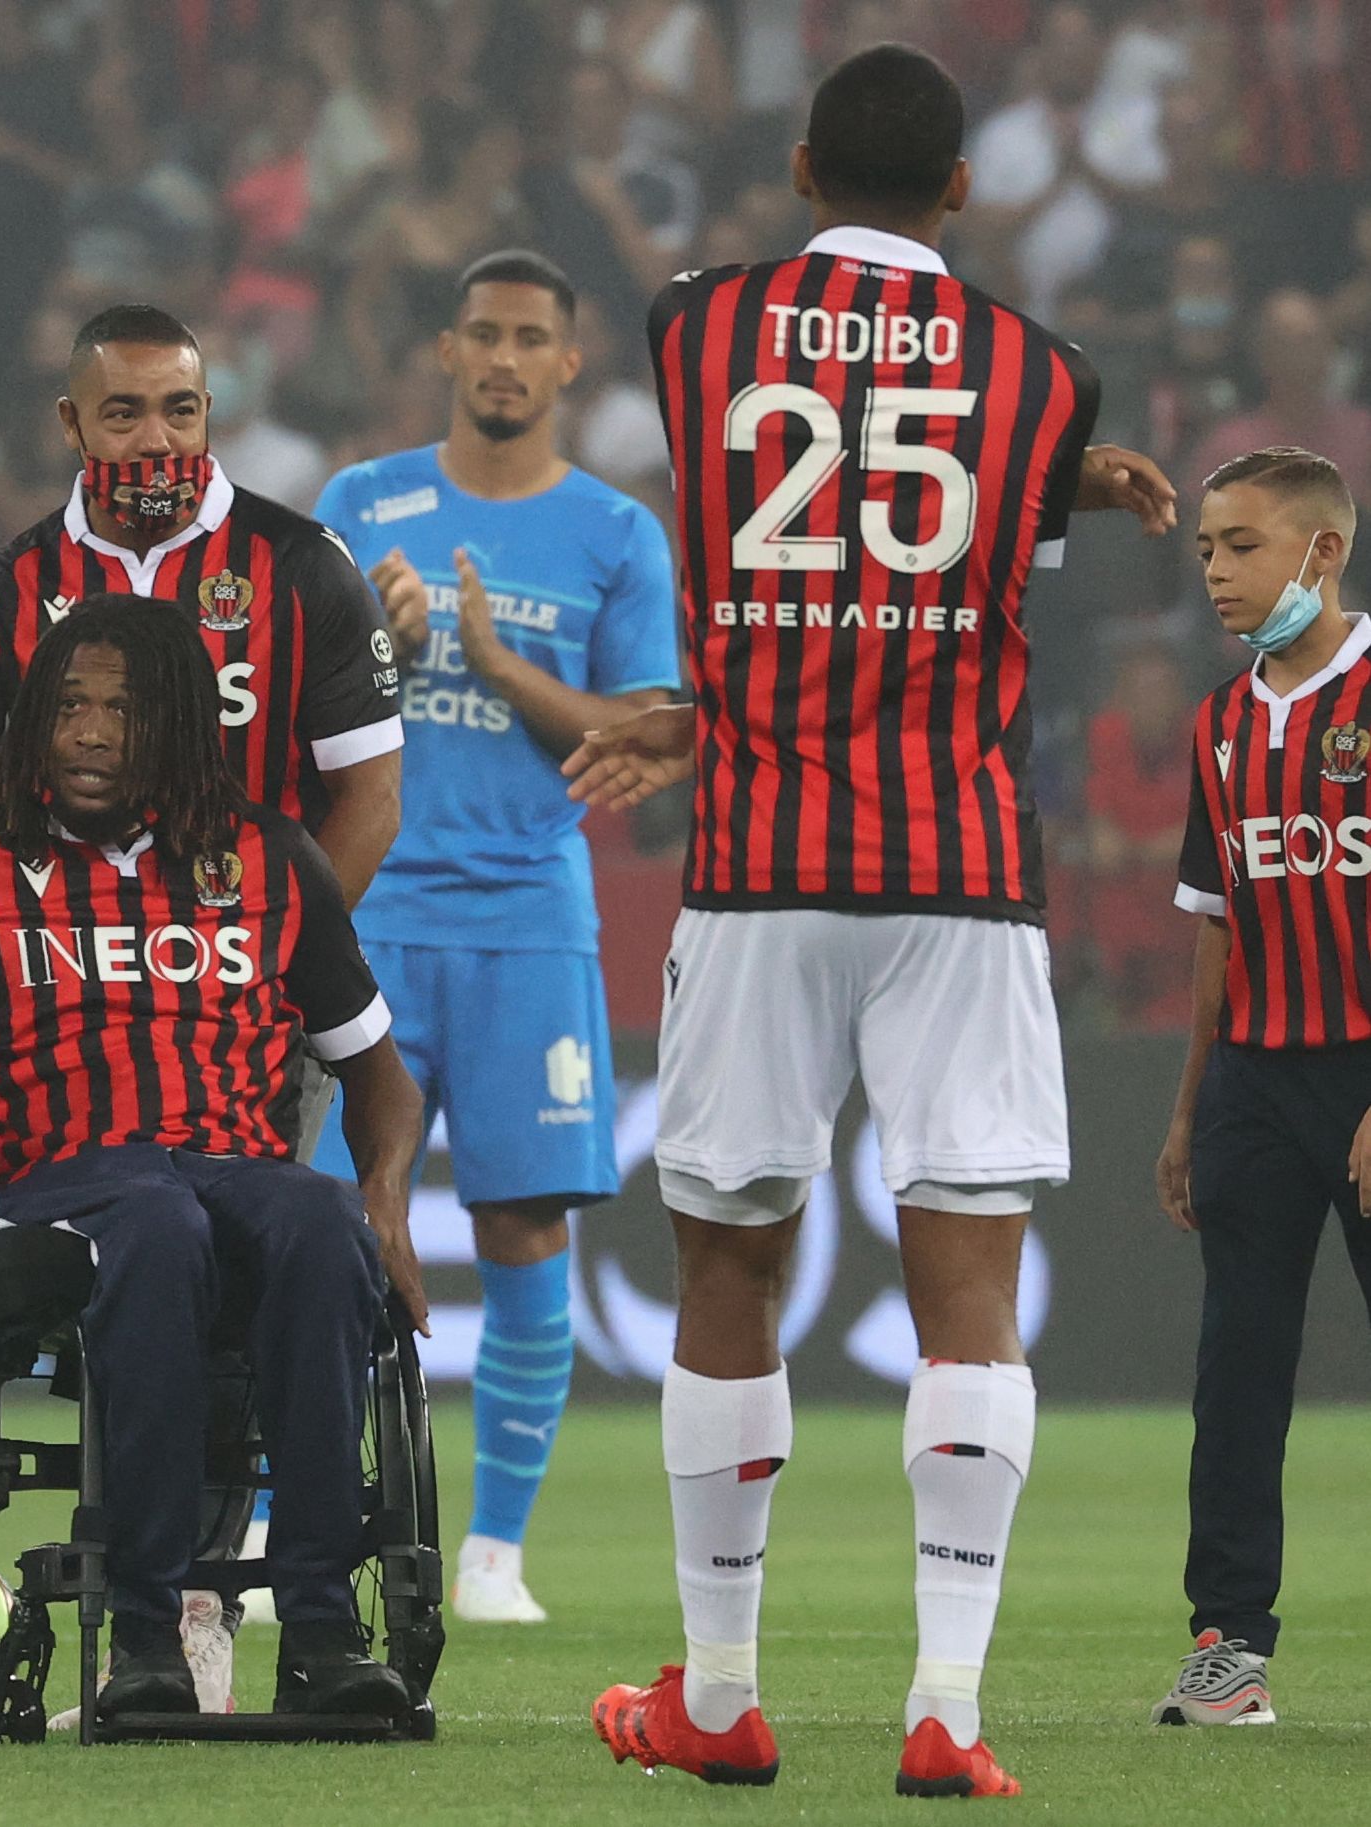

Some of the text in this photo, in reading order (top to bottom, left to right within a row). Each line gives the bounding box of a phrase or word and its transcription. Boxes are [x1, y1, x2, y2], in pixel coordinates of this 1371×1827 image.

[723, 382, 979, 574] 25
[713, 601, 979, 633] GRENADIER
[401, 677, 511, 732] Eats
[11, 923, 255, 988] INEOS
